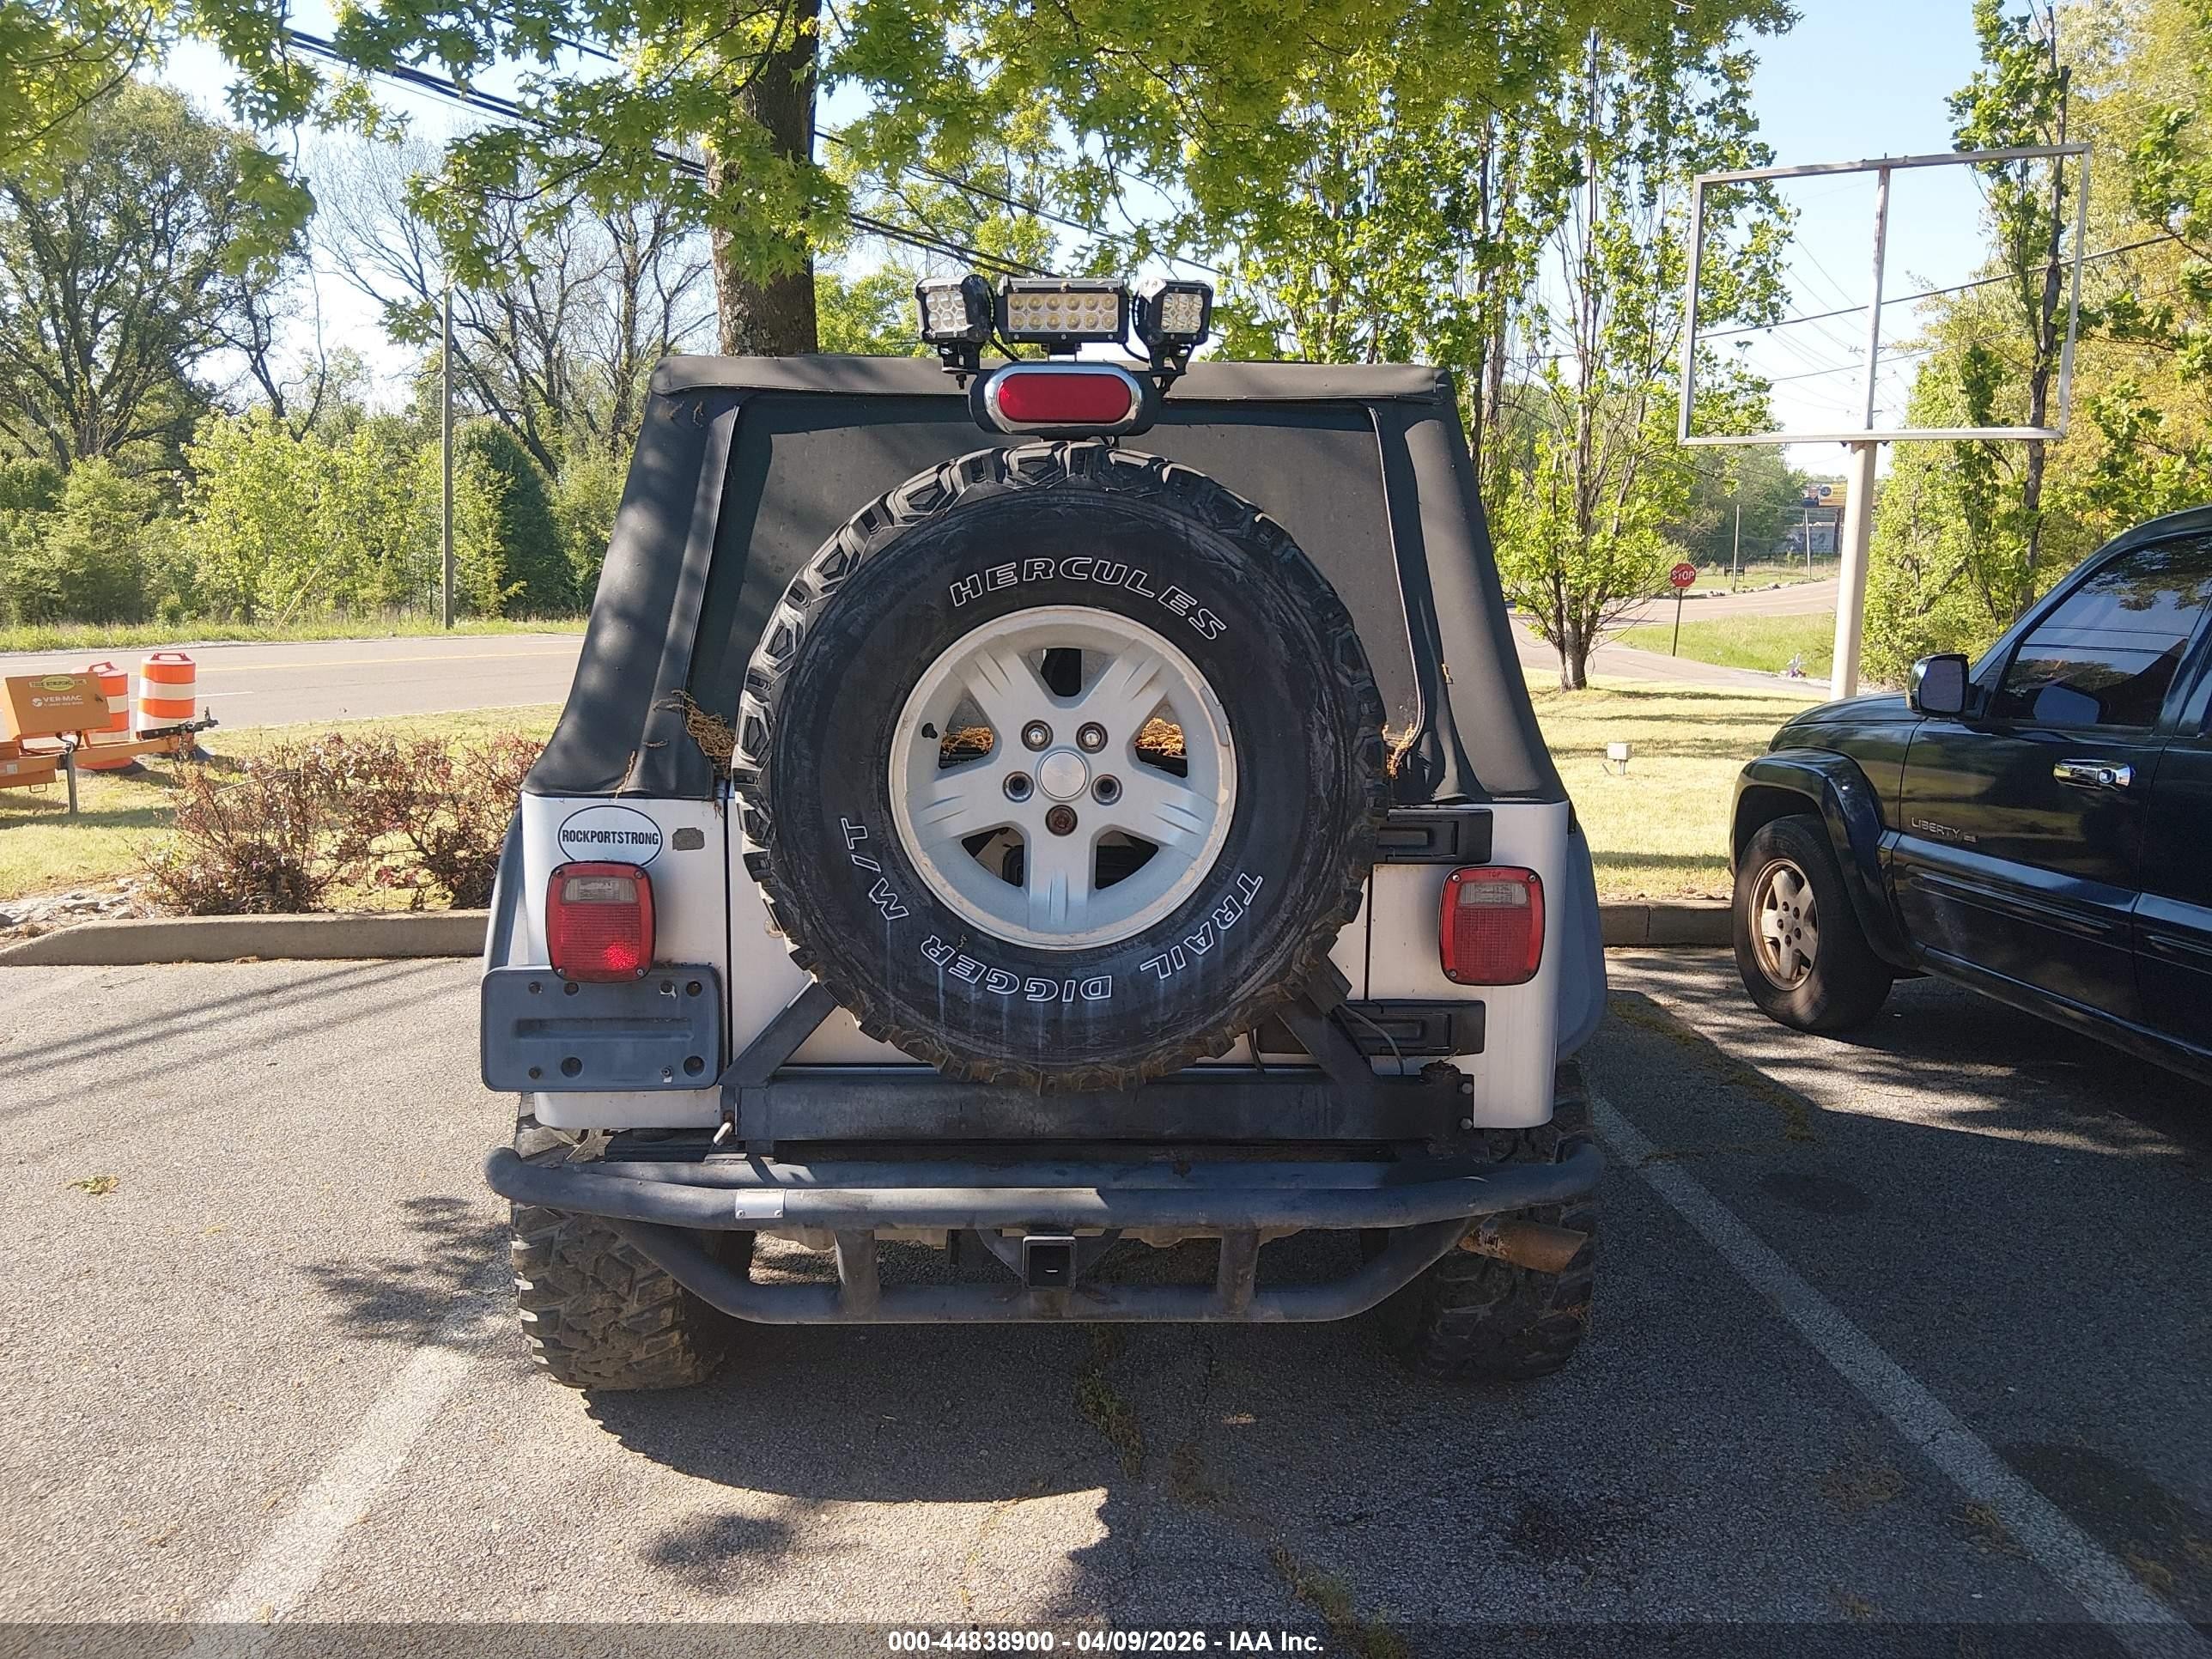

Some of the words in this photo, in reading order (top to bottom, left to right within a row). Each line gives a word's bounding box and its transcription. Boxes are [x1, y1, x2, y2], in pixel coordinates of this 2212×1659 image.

[949, 556, 1227, 640] HERCULES
[1672, 569, 1695, 580] STOP
[562, 830, 659, 845] ROCKPORTSTRONG
[1911, 817, 1960, 839] LIBERTY
[840, 817, 910, 921] M/T
[1139, 872, 1264, 981] TRAIL
[920, 934, 1113, 1003] DIGGER
